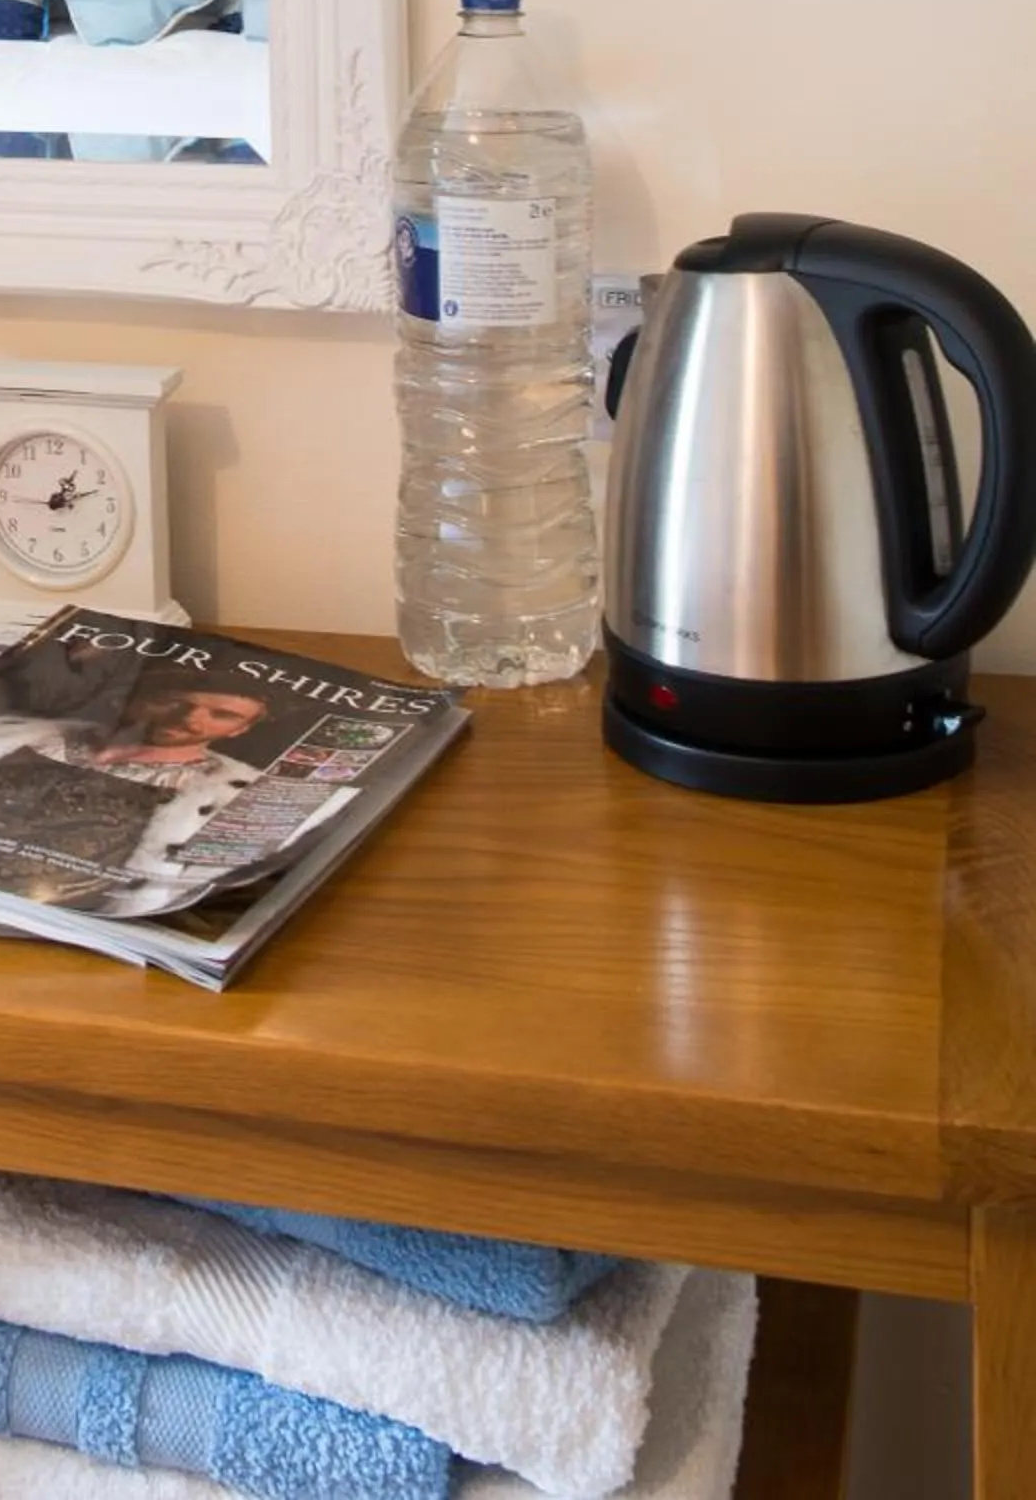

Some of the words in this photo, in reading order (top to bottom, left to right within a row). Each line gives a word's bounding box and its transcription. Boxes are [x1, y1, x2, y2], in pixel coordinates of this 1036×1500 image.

[22, 444, 37, 461] 11
[43, 438, 64, 456] 12
[79, 449, 87, 466] 1
[3, 462, 21, 479] 10
[96, 468, 106, 485] 2
[105, 497, 116, 514] 3
[8, 517, 19, 533] 8
[96, 521, 107, 537] 4
[27, 537, 37, 554] 7
[80, 540, 90, 558] 5
[52, 548, 63, 563] 6
[55, 621, 213, 672] FOUR
[235, 658, 437, 716] SHIRES
